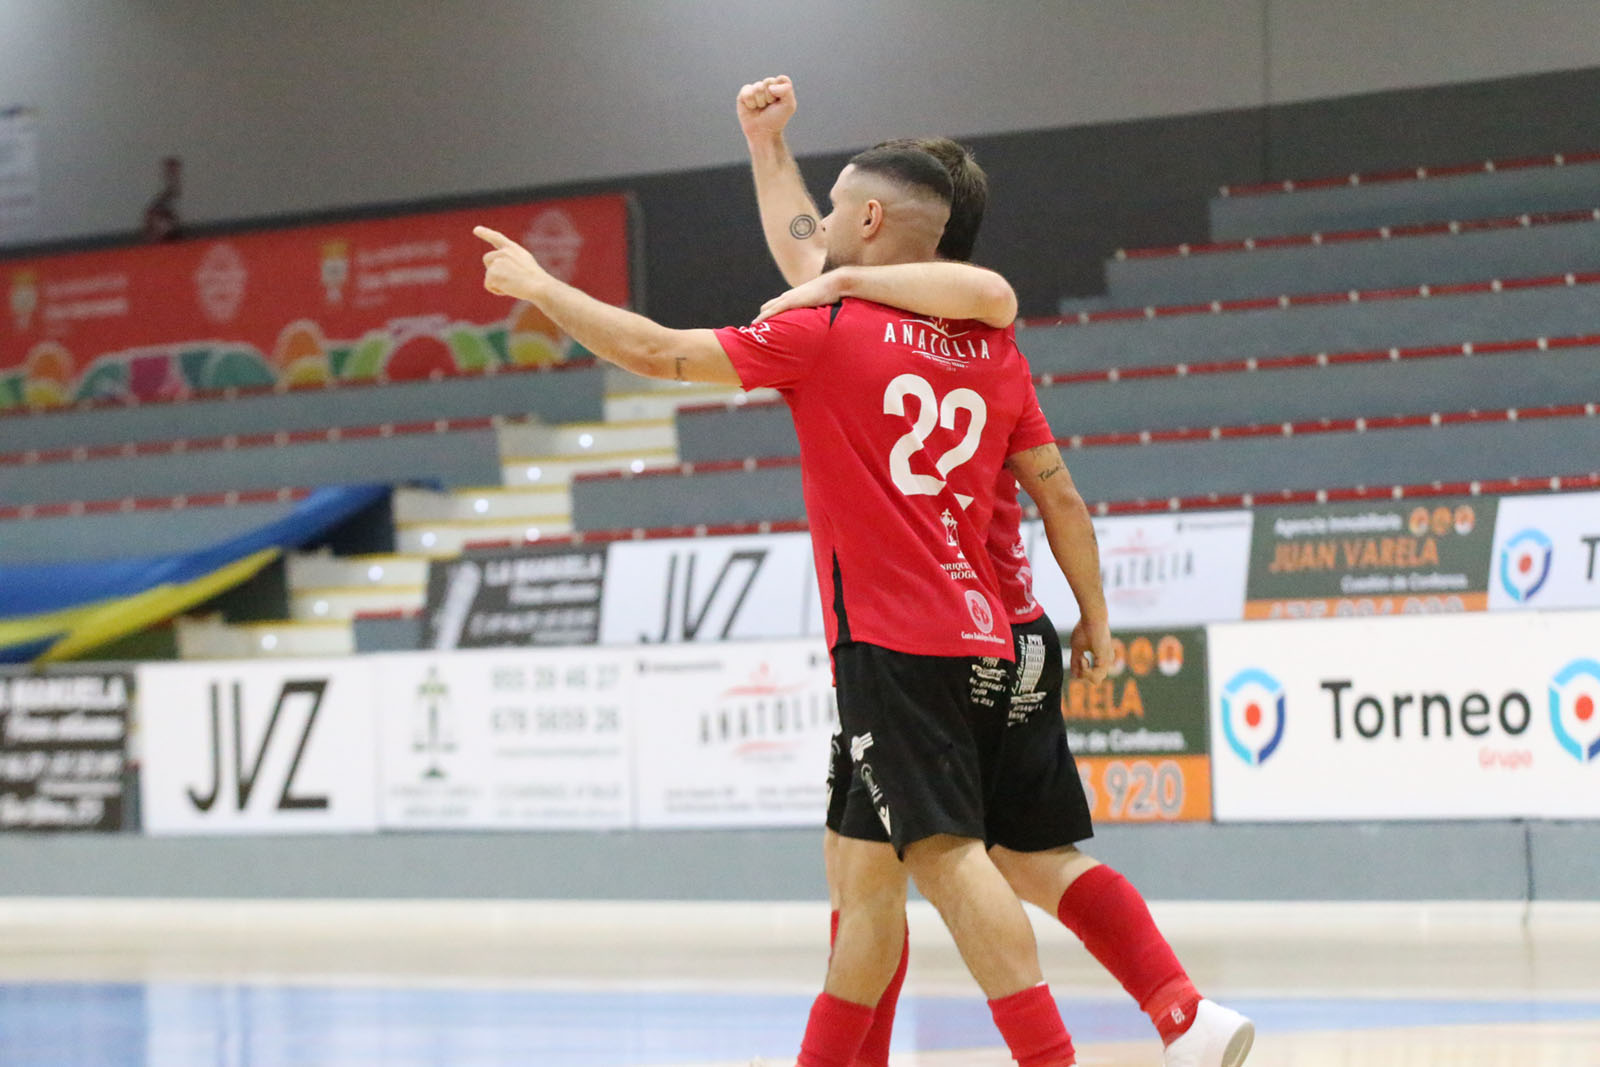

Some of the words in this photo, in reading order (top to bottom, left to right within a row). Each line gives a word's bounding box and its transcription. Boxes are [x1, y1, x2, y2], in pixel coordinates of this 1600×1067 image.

[884, 322, 990, 359] ANATOLIA
[883, 374, 987, 508] 22
[1268, 541, 1336, 573] JUAN
[1343, 537, 1439, 569] VARELA
[1061, 678, 1145, 720] RELA
[1320, 680, 1531, 740] Torneo
[186, 679, 331, 812] JVZ
[1477, 747, 1533, 770] Grupo
[1104, 760, 1185, 819] 920
